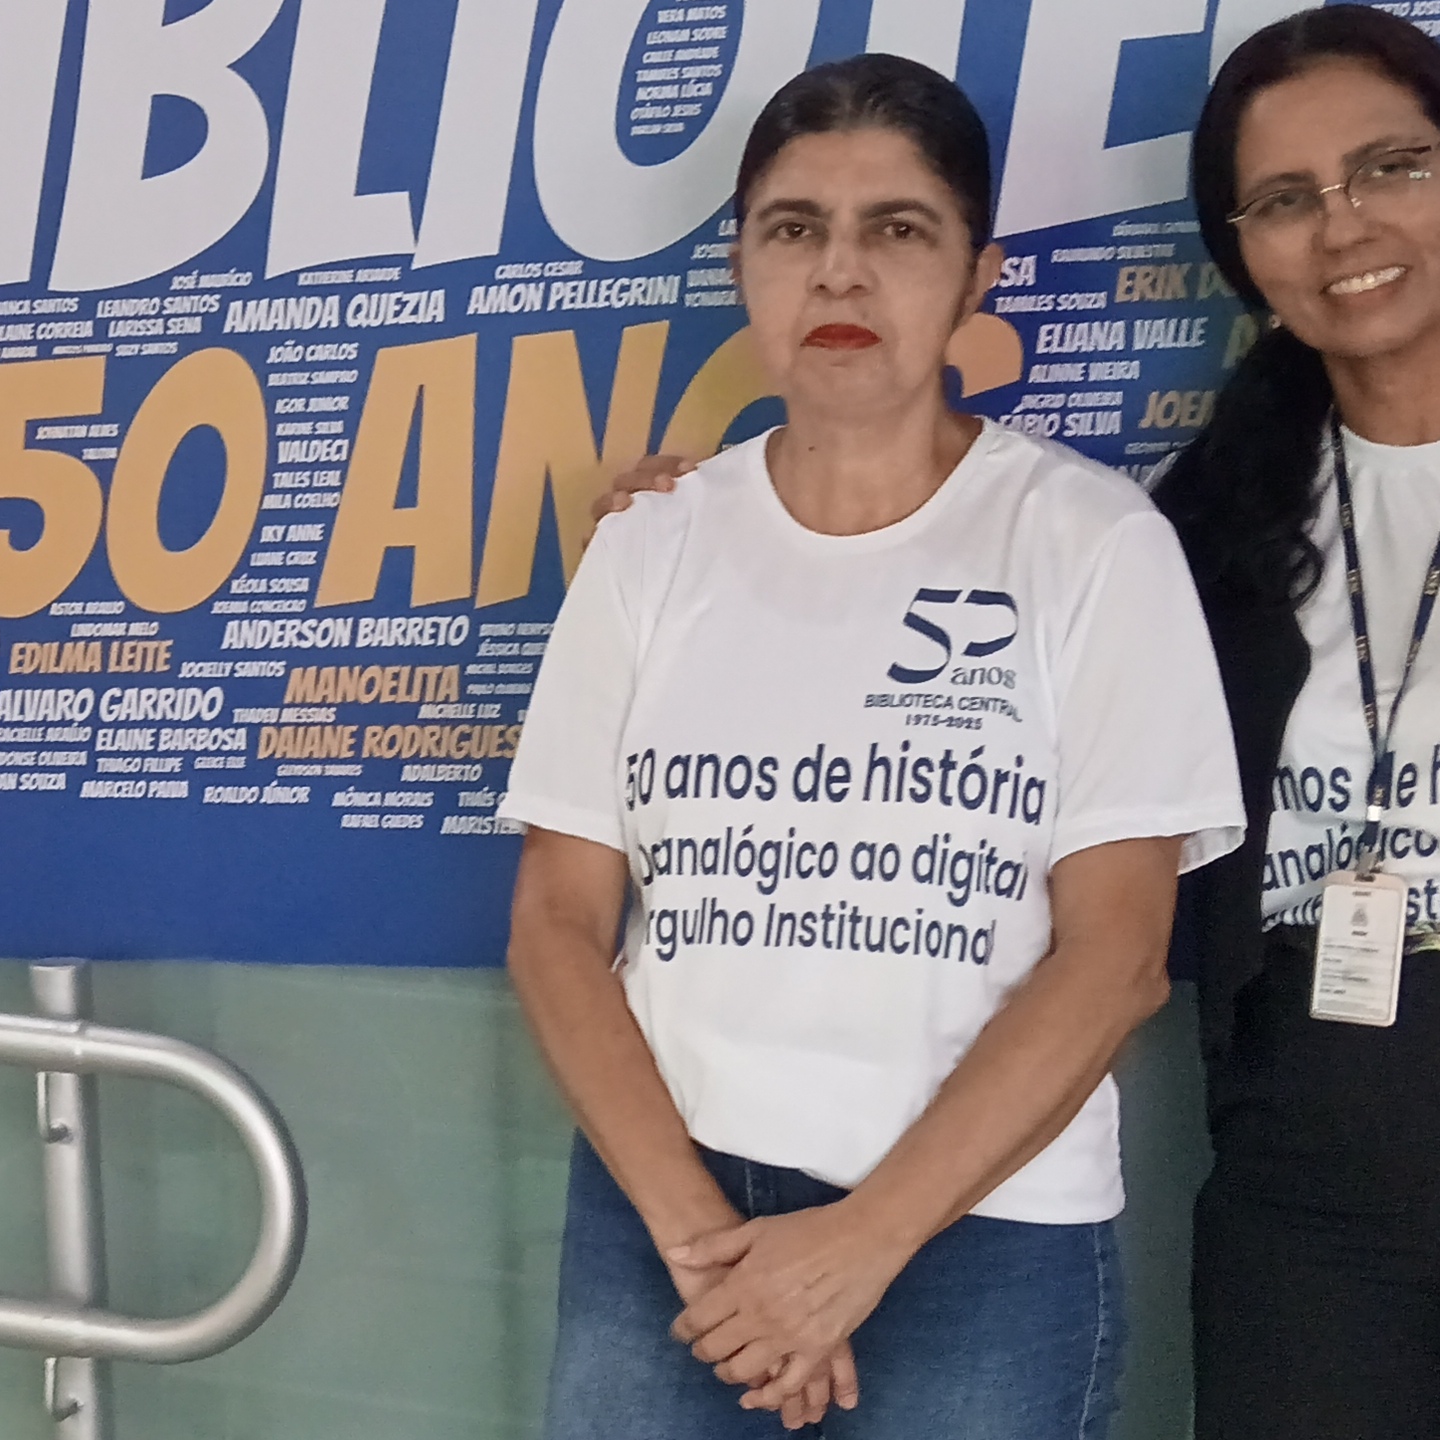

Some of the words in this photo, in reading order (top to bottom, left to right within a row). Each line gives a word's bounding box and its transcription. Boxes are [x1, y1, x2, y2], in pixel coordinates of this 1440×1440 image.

[223, 295, 339, 333] AMANDA
[346, 290, 444, 327] QUEZIA
[467, 282, 545, 314] AMON
[547, 275, 680, 311] PELLEGRINI
[314, 312, 1024, 610] AN
[221, 618, 353, 649] ANDERSON
[356, 616, 469, 647] BARRETO
[9, 641, 101, 674] EDILMA
[108, 640, 173, 672] LEITE
[284, 665, 459, 703] MANOELITA
[950, 665, 1016, 690] anos
[864, 693, 955, 710] BIBLIOTECA
[257, 725, 358, 759] DAIANE
[362, 722, 522, 759] RODRIGUES
[665, 752, 778, 800] anos
[792, 743, 852, 803] de
[862, 740, 1046, 824] história
[851, 837, 902, 882] ao
[645, 897, 754, 961] rgulho
[764, 903, 996, 965] Instituciona
